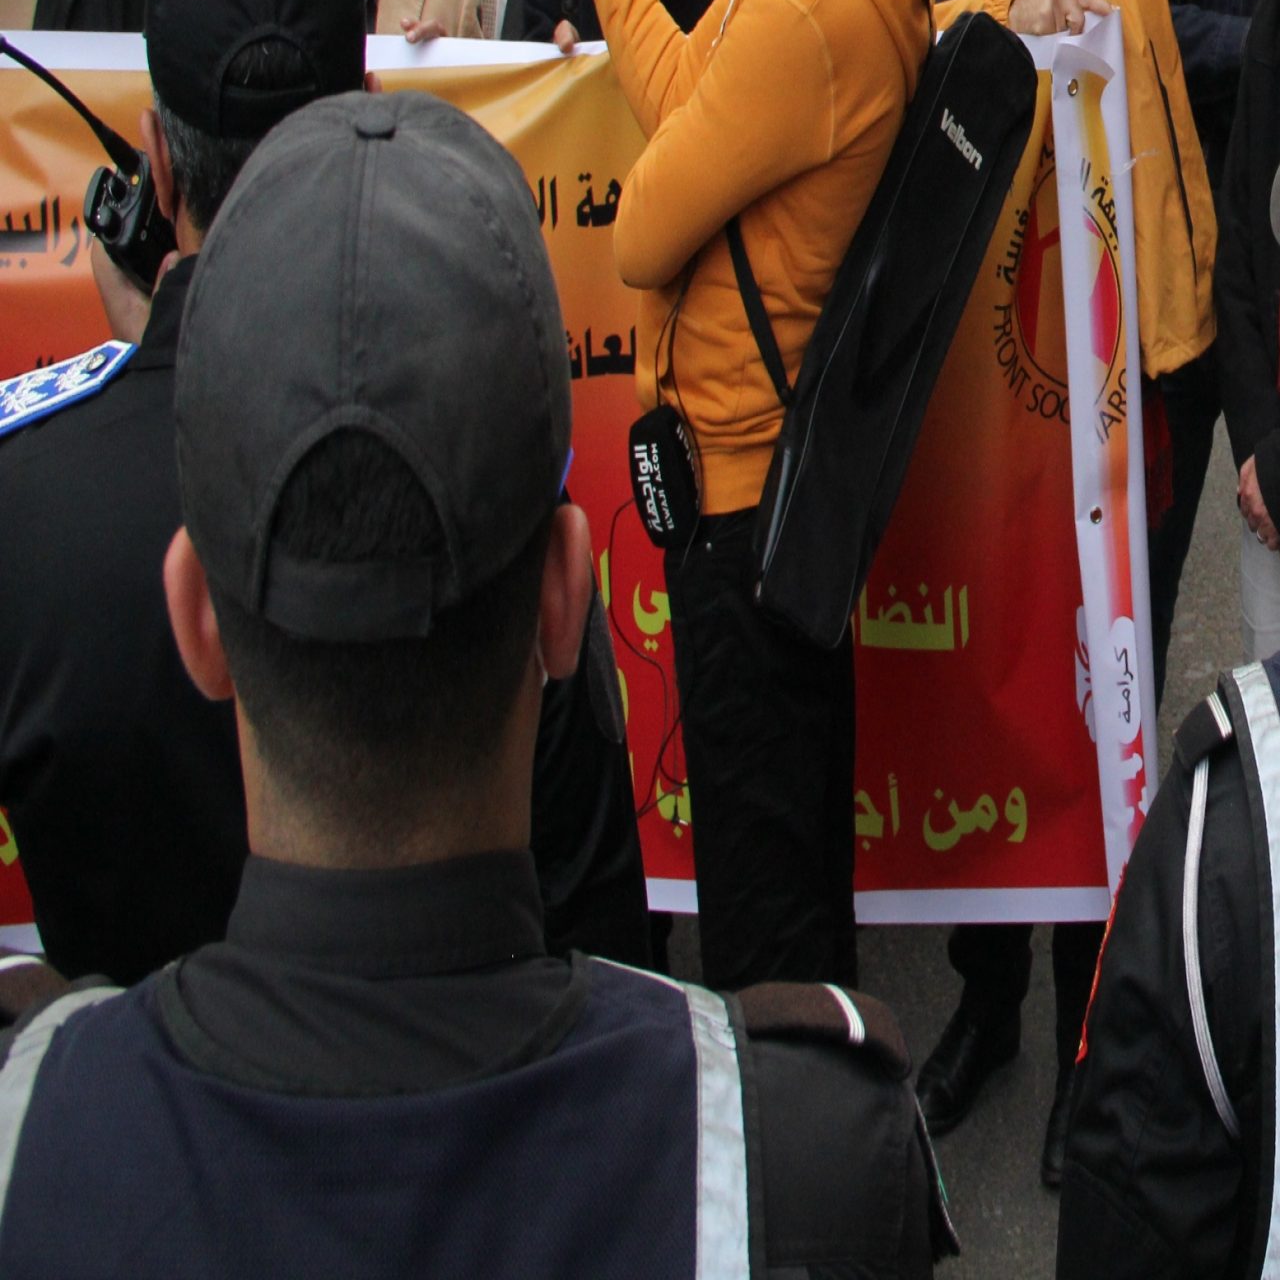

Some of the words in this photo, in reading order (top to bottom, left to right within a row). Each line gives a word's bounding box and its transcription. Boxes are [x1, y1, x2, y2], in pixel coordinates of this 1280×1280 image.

[939, 107, 984, 171] Velbon
[993, 303, 1032, 399] FRONT
[1026, 383, 1071, 426] SOC
[633, 442, 664, 533] الواجهة
[852, 583, 970, 651] النضا
[1114, 644, 1135, 724] كرامة
[854, 772, 901, 851] أج
[921, 785, 1029, 853] ومن
